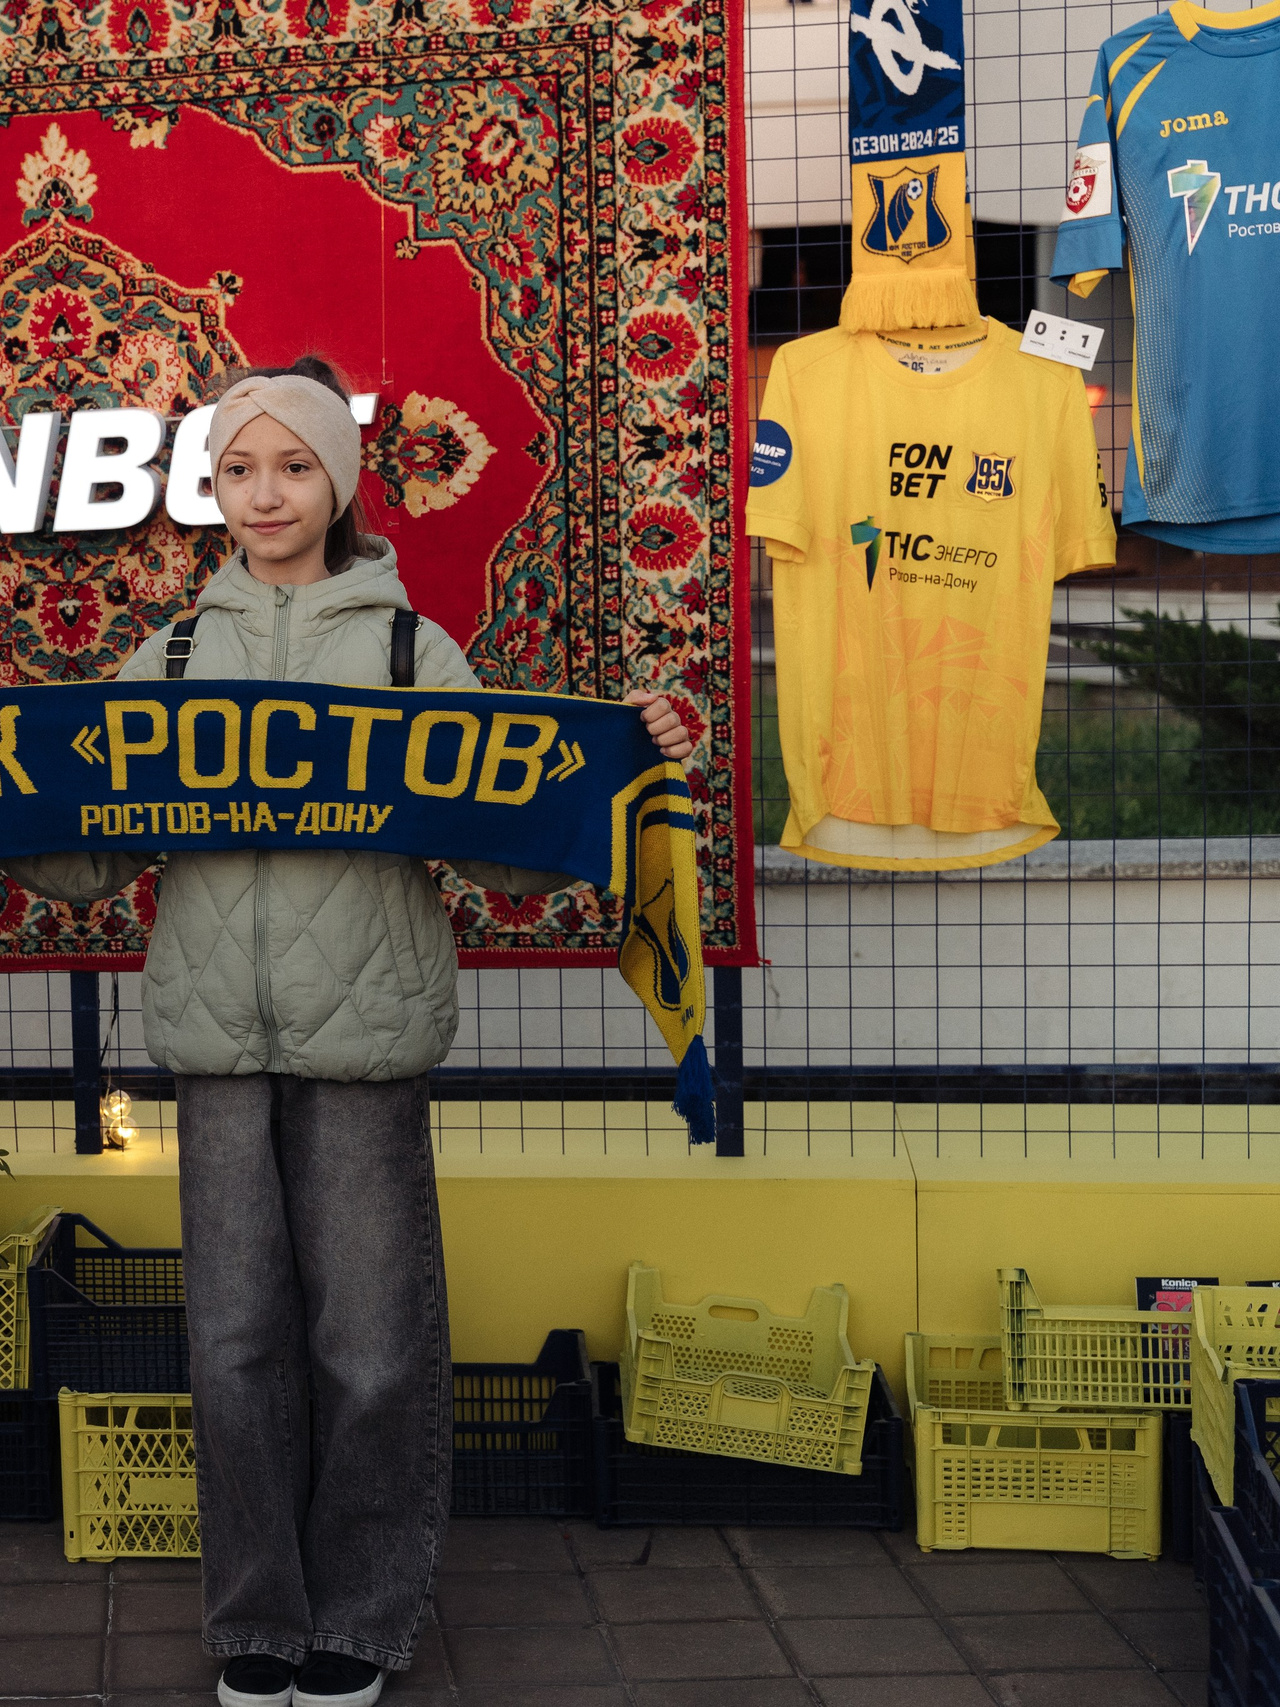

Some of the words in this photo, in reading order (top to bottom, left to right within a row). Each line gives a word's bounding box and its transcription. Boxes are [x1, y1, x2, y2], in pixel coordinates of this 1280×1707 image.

[852, 133, 899, 156] СЕЗОН
[900, 125, 959, 151] 2024/25
[1034, 321, 1047, 336] 0
[1081, 335, 1089, 348] 1
[889, 443, 953, 470] FON
[890, 472, 947, 499] BET
[978, 458, 1005, 490] 95
[934, 545, 998, 568] ЭНЕРГО
[70, 698, 587, 805] «РОСТОВ»
[80, 803, 394, 836] РОСТОВ-НА-ДОНУ
[1161, 1279, 1198, 1287] Konica
